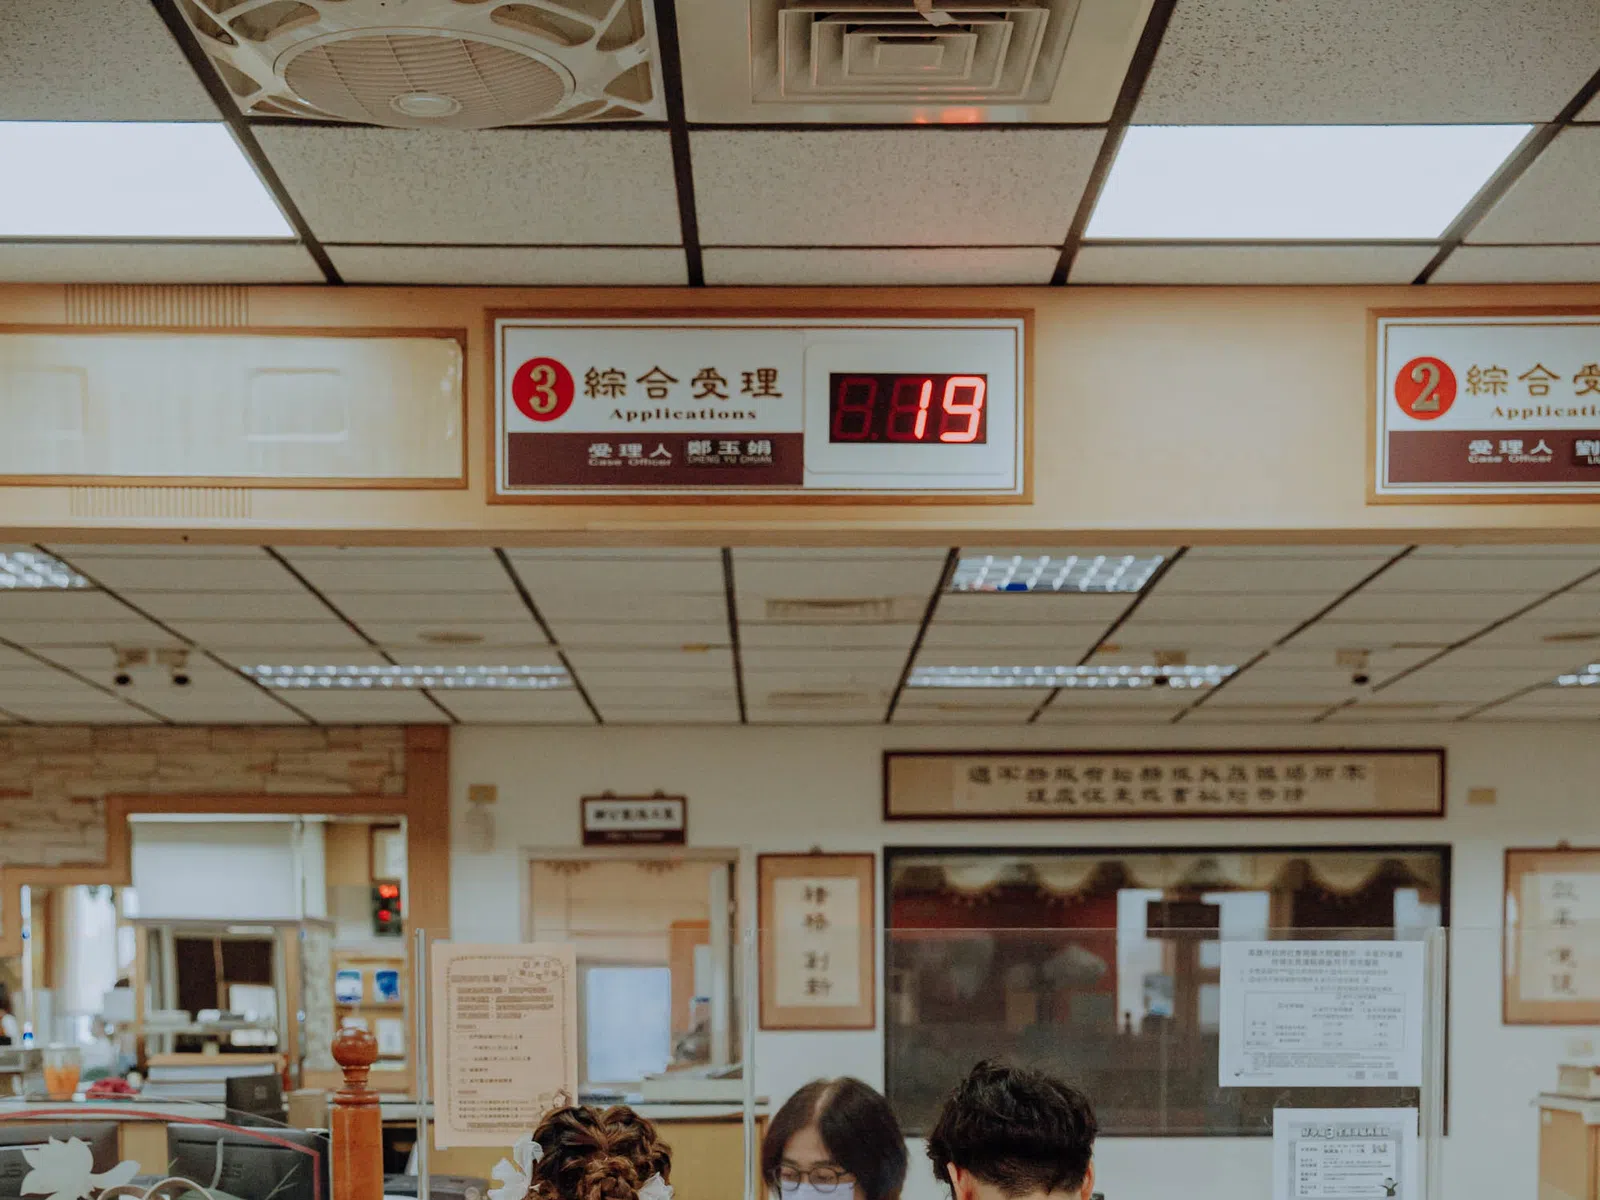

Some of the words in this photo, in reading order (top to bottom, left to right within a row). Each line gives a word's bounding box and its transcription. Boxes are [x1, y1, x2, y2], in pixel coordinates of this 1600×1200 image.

[529, 364, 558, 414] 3
[584, 366, 783, 399] 綜合受理
[1411, 362, 1441, 411] 2
[609, 406, 757, 422] Applications
[914, 376, 986, 442] 19
[1491, 404, 1600, 421] Applicati
[588, 443, 672, 458] 受理人
[1468, 439, 1553, 455] 受理人
